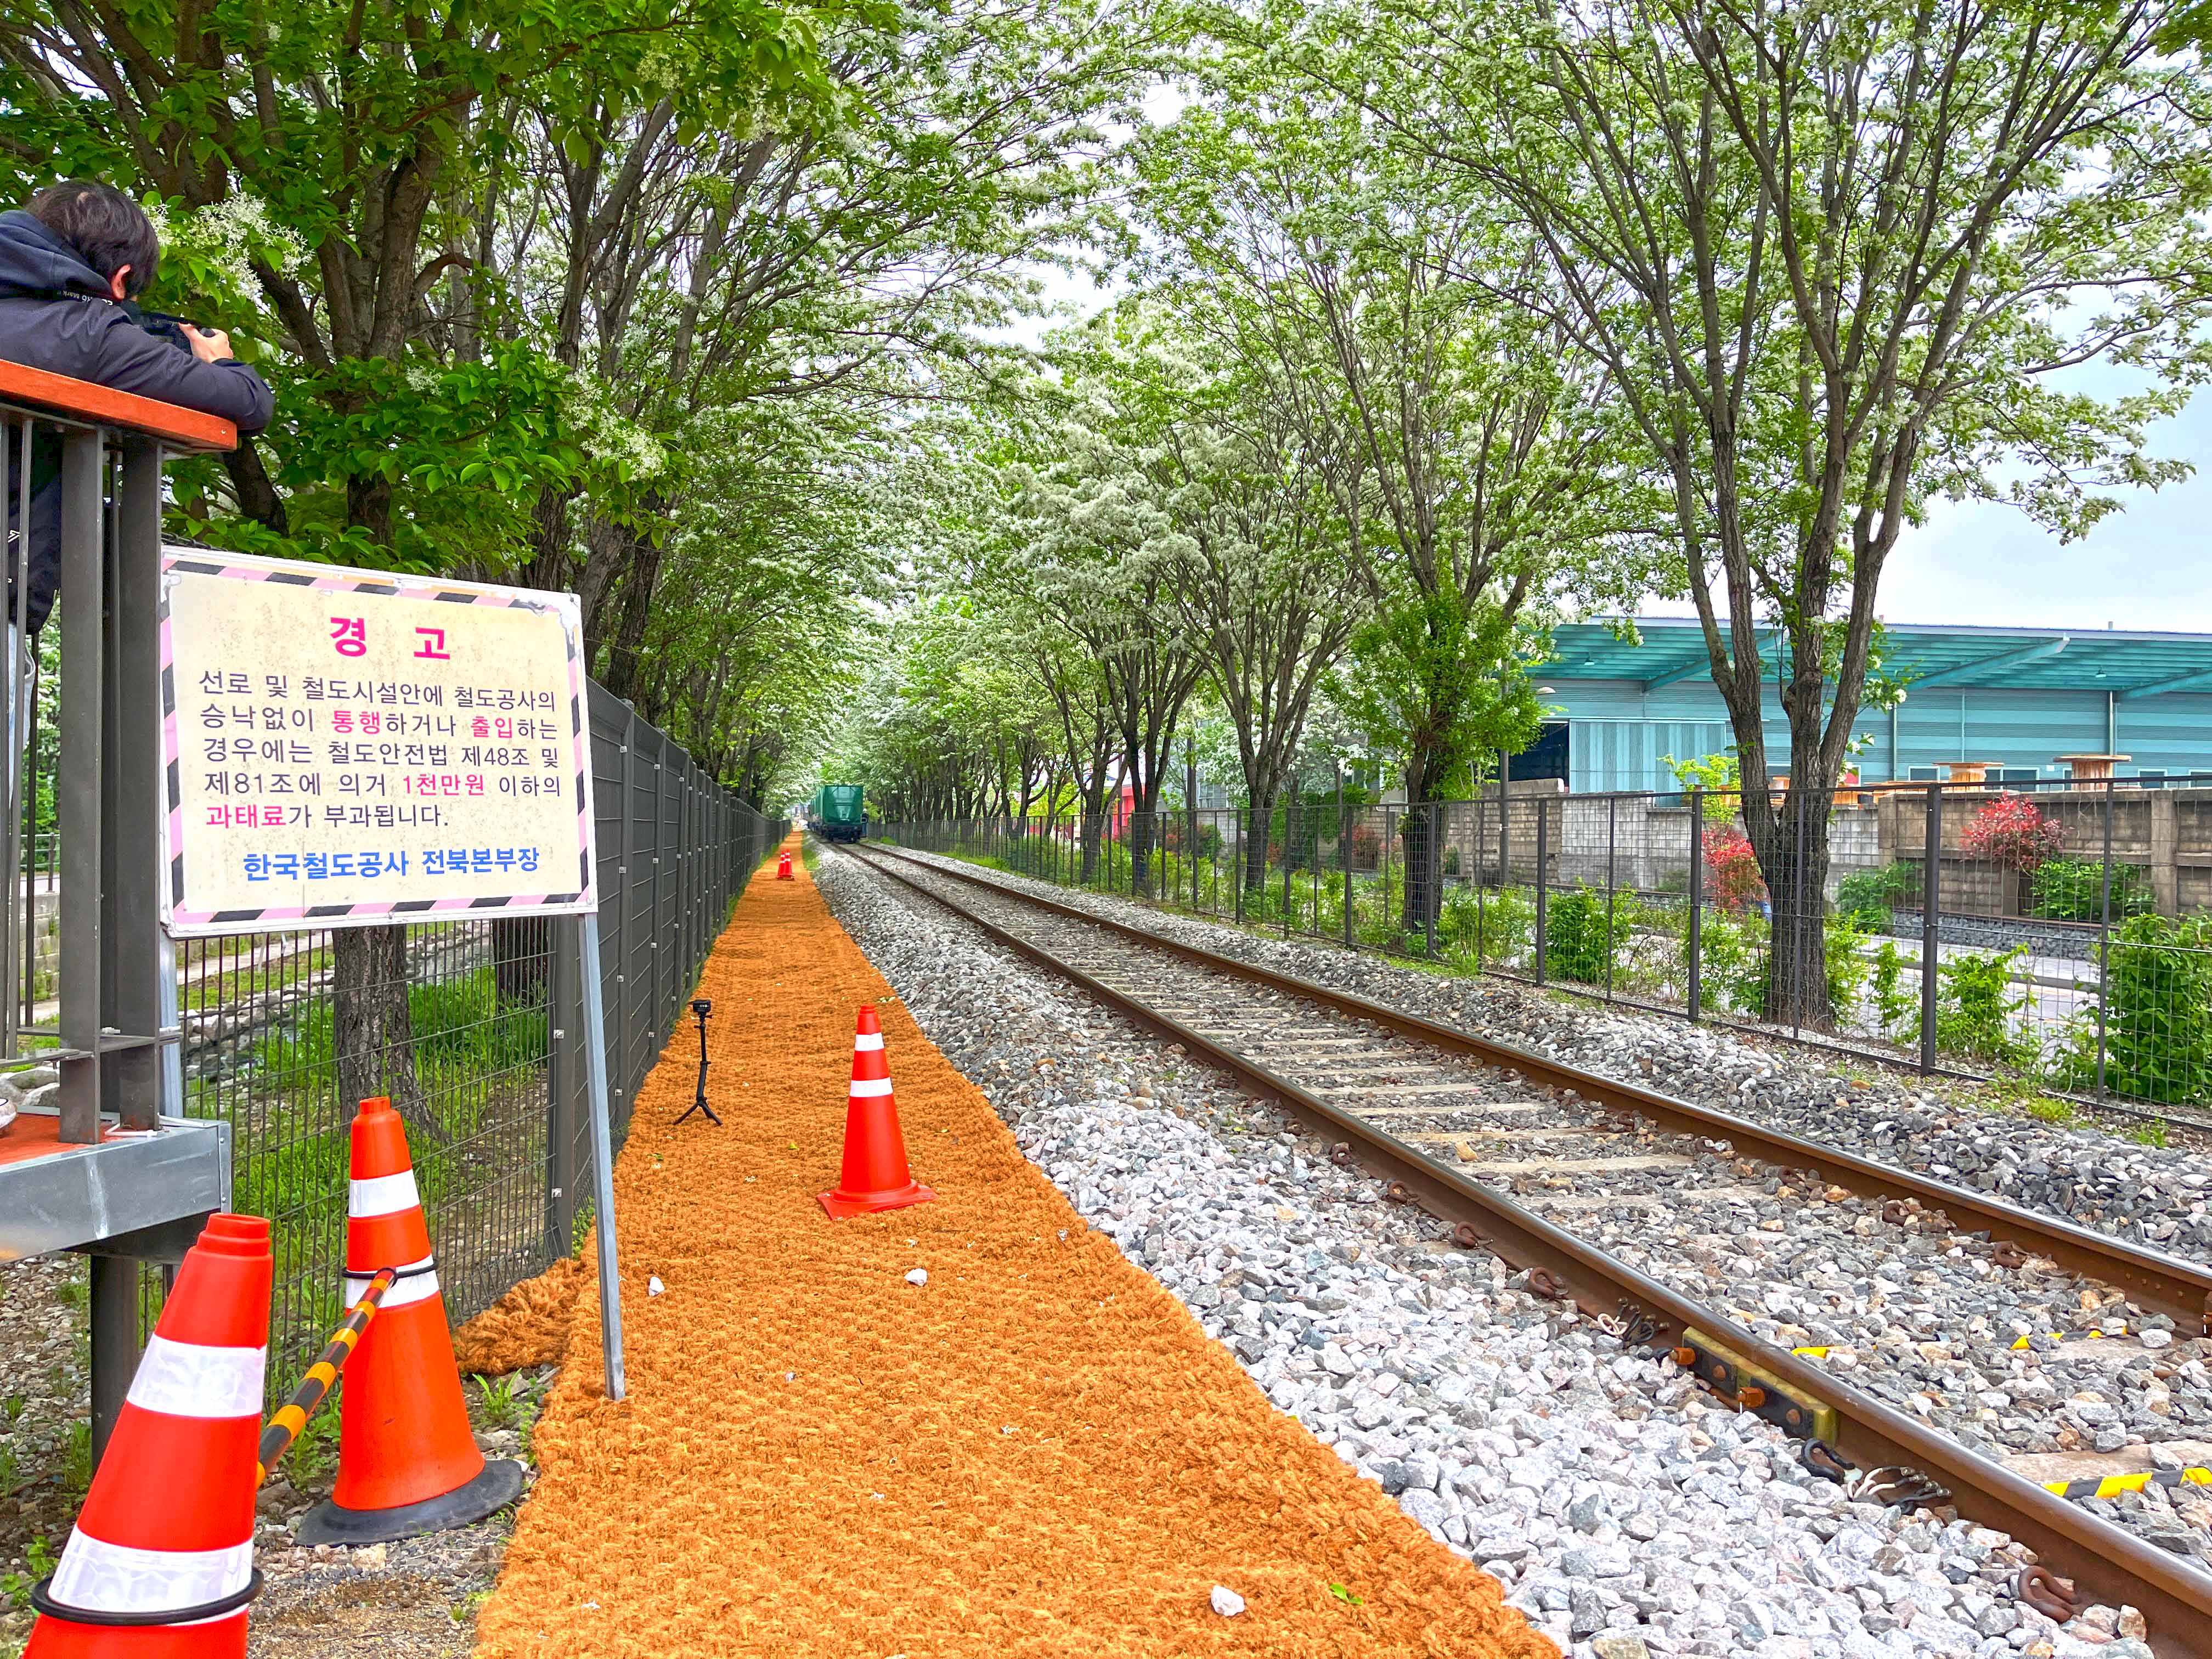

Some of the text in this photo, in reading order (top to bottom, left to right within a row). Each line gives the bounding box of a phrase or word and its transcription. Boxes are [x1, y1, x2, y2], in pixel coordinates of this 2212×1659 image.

[330, 617, 450, 660] 경 고
[199, 670, 555, 712] 선로 및 철도시설안에 철도공사의
[200, 703, 557, 740] 승낙없이 통행하거나 출입하는
[204, 737, 558, 768] 경우에는 철도안전법 제48조 및
[205, 771, 560, 797] 제81조에 의거 1천만원 이하의
[206, 804, 449, 829] 과태료가 부과됩니다.
[244, 847, 539, 881] 한국철도공사 전북본부장
